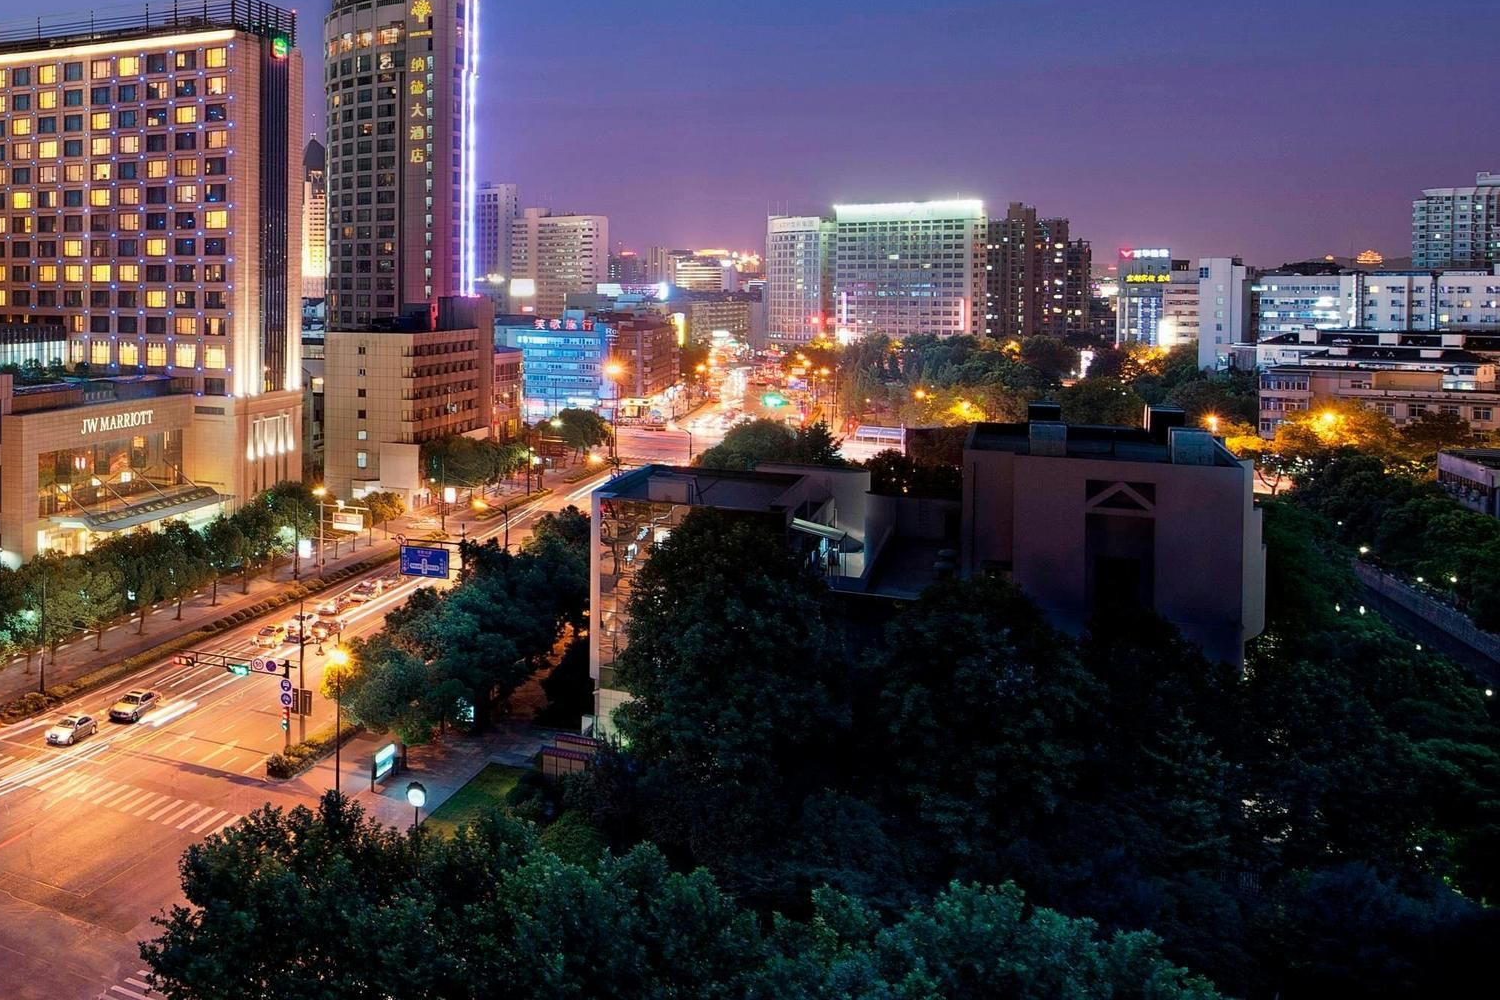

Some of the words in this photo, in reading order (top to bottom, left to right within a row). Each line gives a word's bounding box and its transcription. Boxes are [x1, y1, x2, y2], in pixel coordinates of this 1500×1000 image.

[410, 57, 425, 163] 纳德大酒店
[81, 418, 99, 435] JW
[100, 410, 154, 431] MARRIOTT
